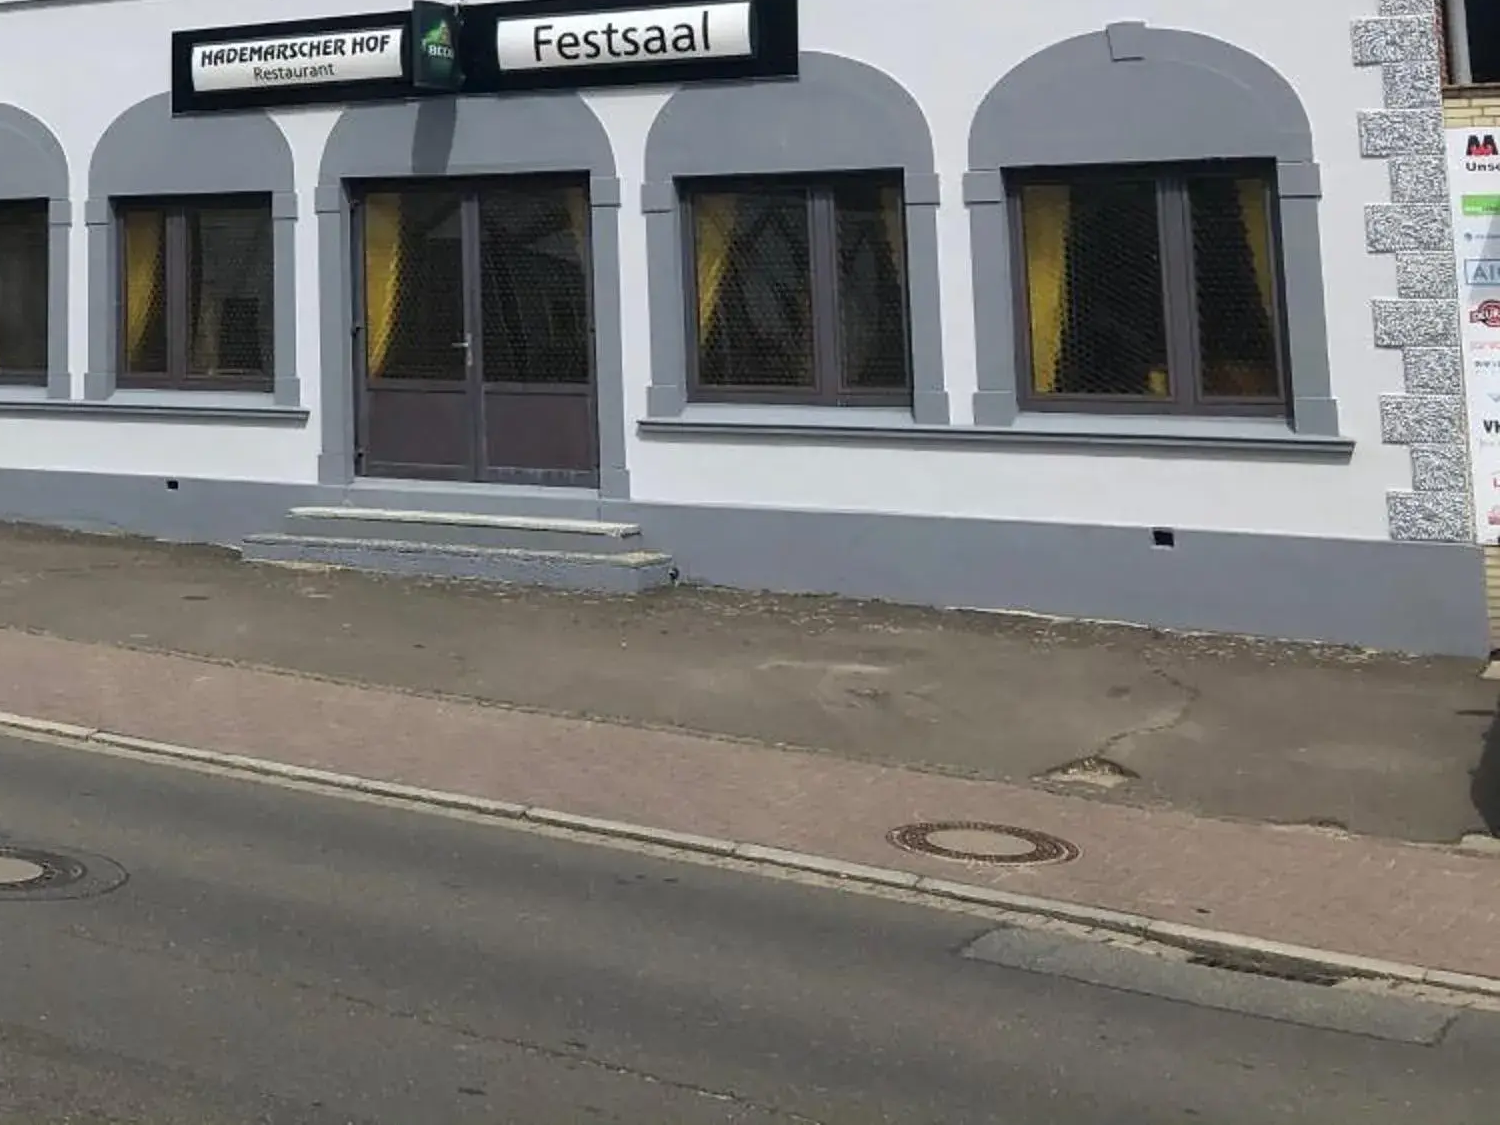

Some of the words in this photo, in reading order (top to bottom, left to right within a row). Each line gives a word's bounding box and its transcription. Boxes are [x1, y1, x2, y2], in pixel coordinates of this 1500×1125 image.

[533, 10, 711, 62] Festsaal
[200, 39, 347, 67] HADEMARSCHER
[351, 34, 390, 56] HOF
[253, 63, 336, 82] Restaurant
[1473, 263, 1500, 281] AI
